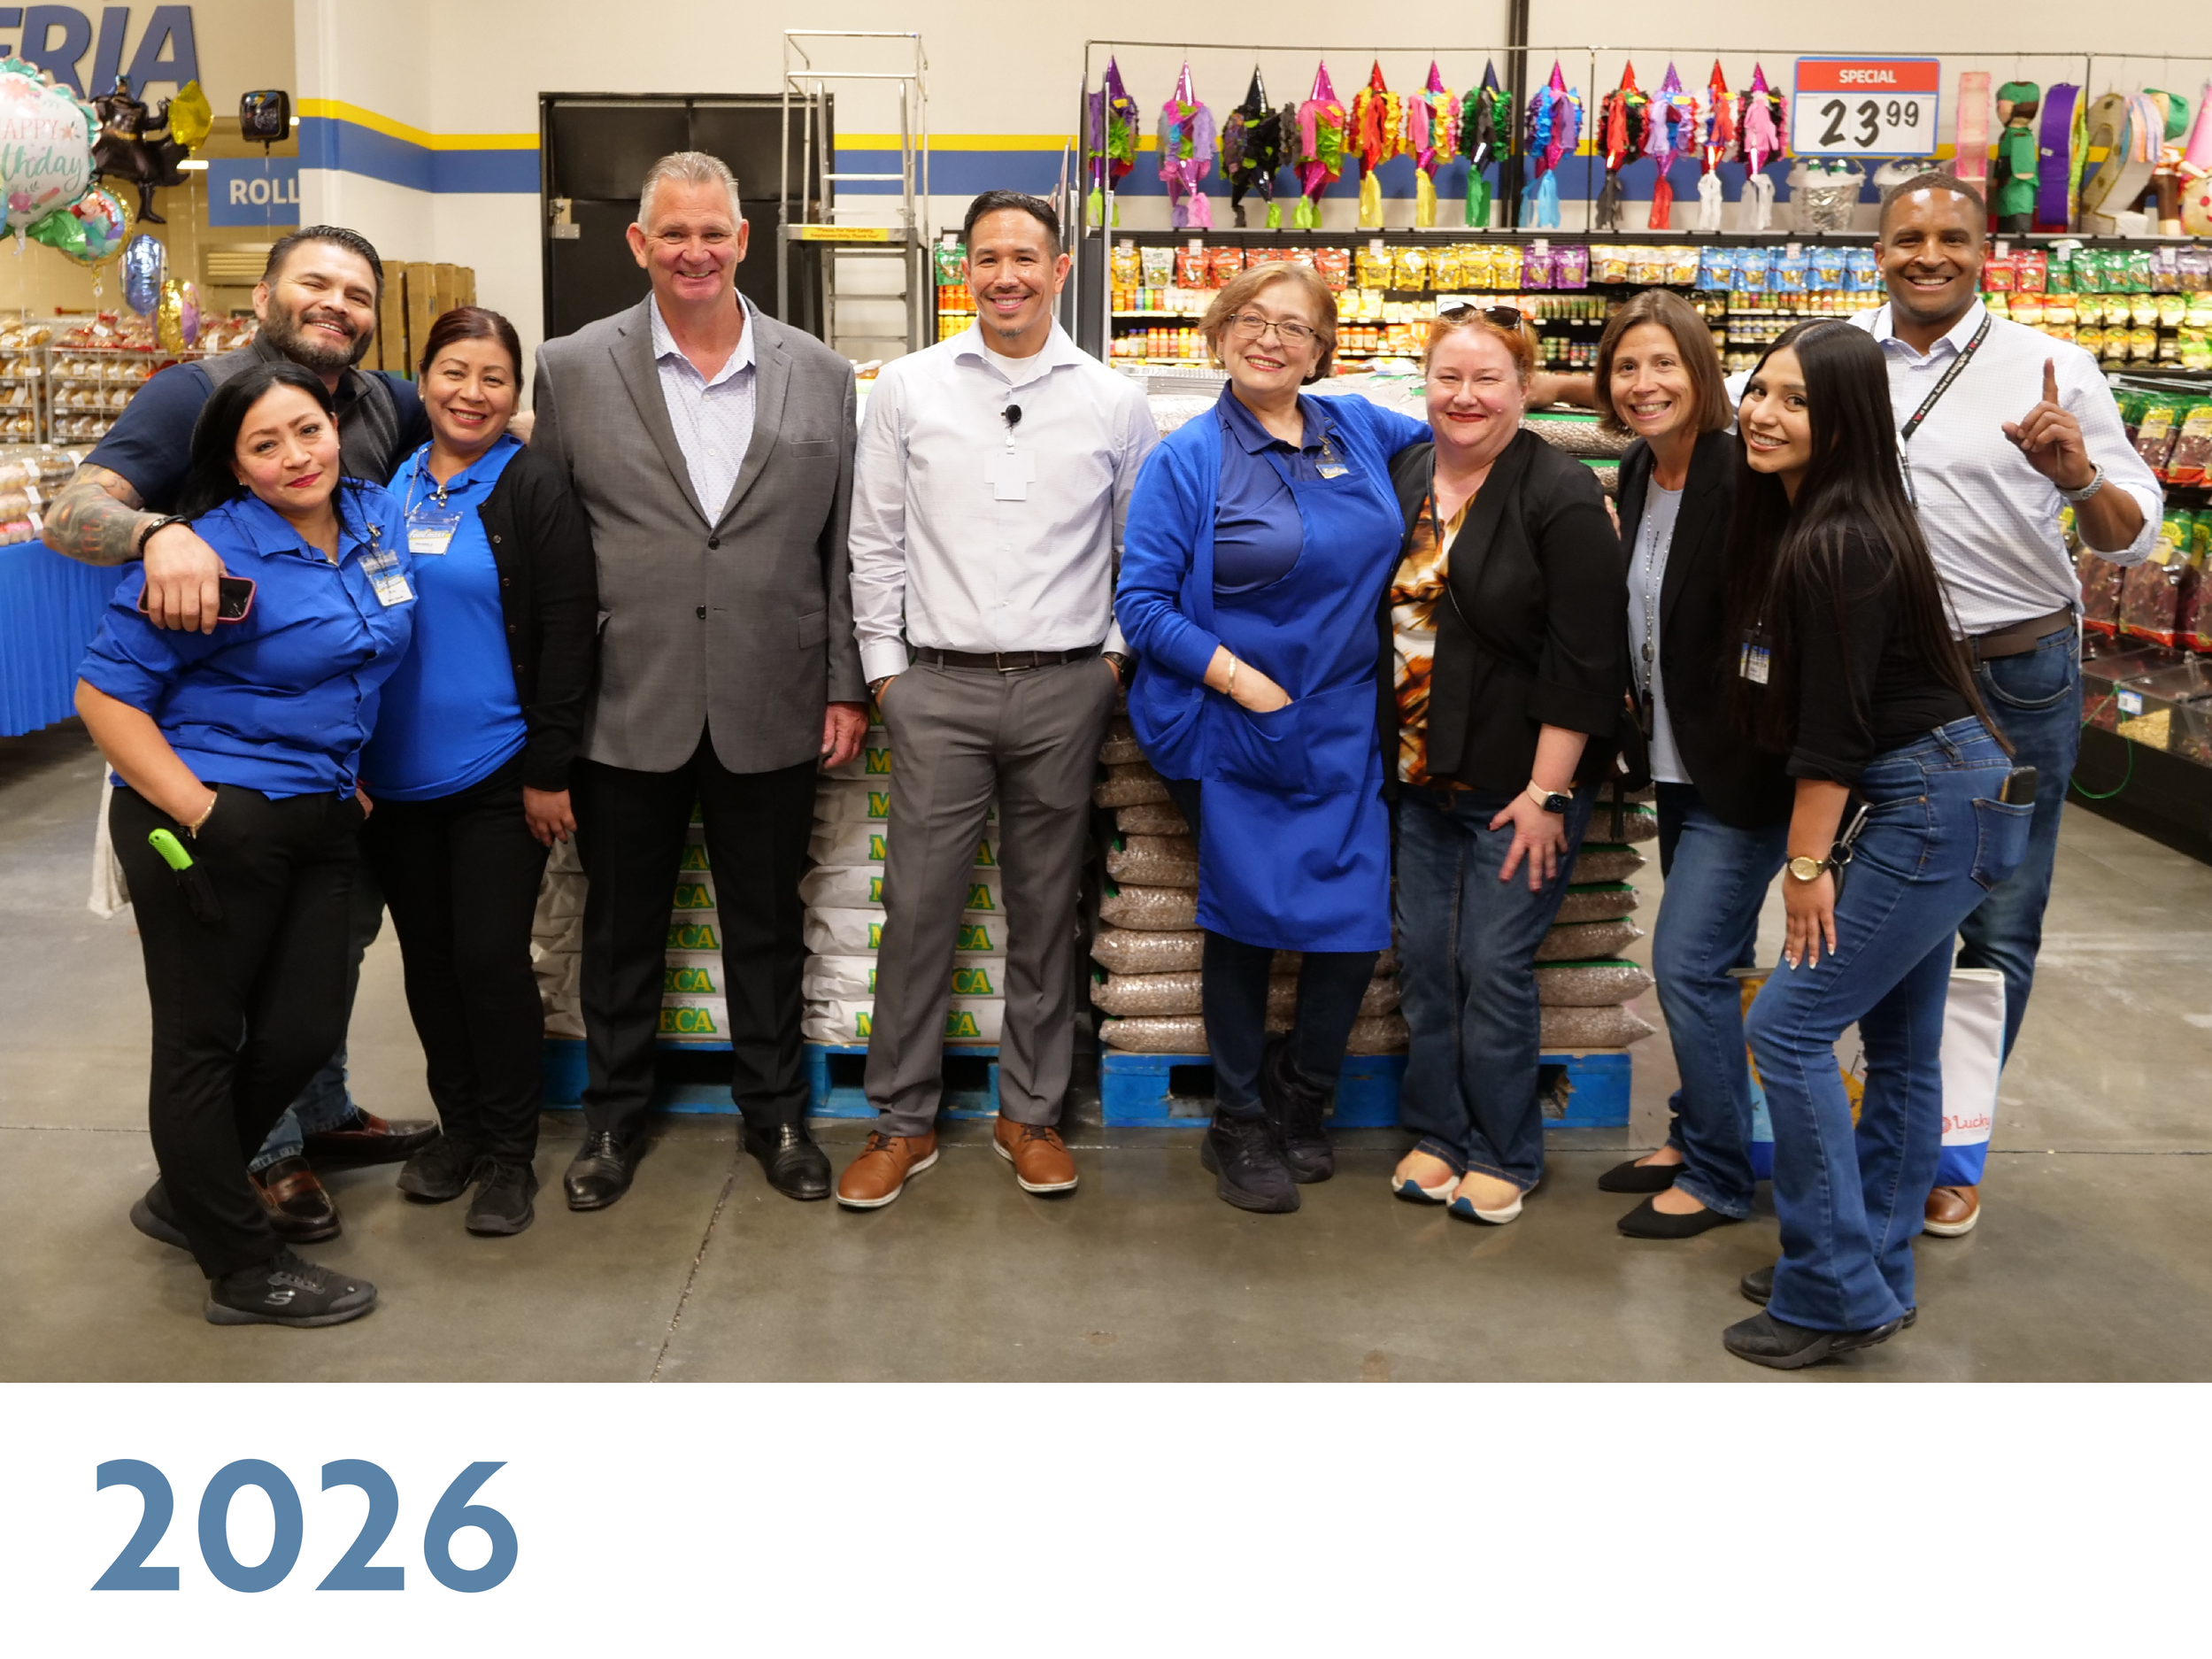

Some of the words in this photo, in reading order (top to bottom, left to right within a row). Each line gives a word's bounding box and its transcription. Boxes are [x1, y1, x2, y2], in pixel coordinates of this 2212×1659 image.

[1838, 69, 1897, 83] SPECIAL
[1818, 98, 1880, 148] 23
[1886, 100, 1919, 127] 99
[230, 178, 299, 204] ROLL
[1953, 1113, 1990, 1130] Lucky
